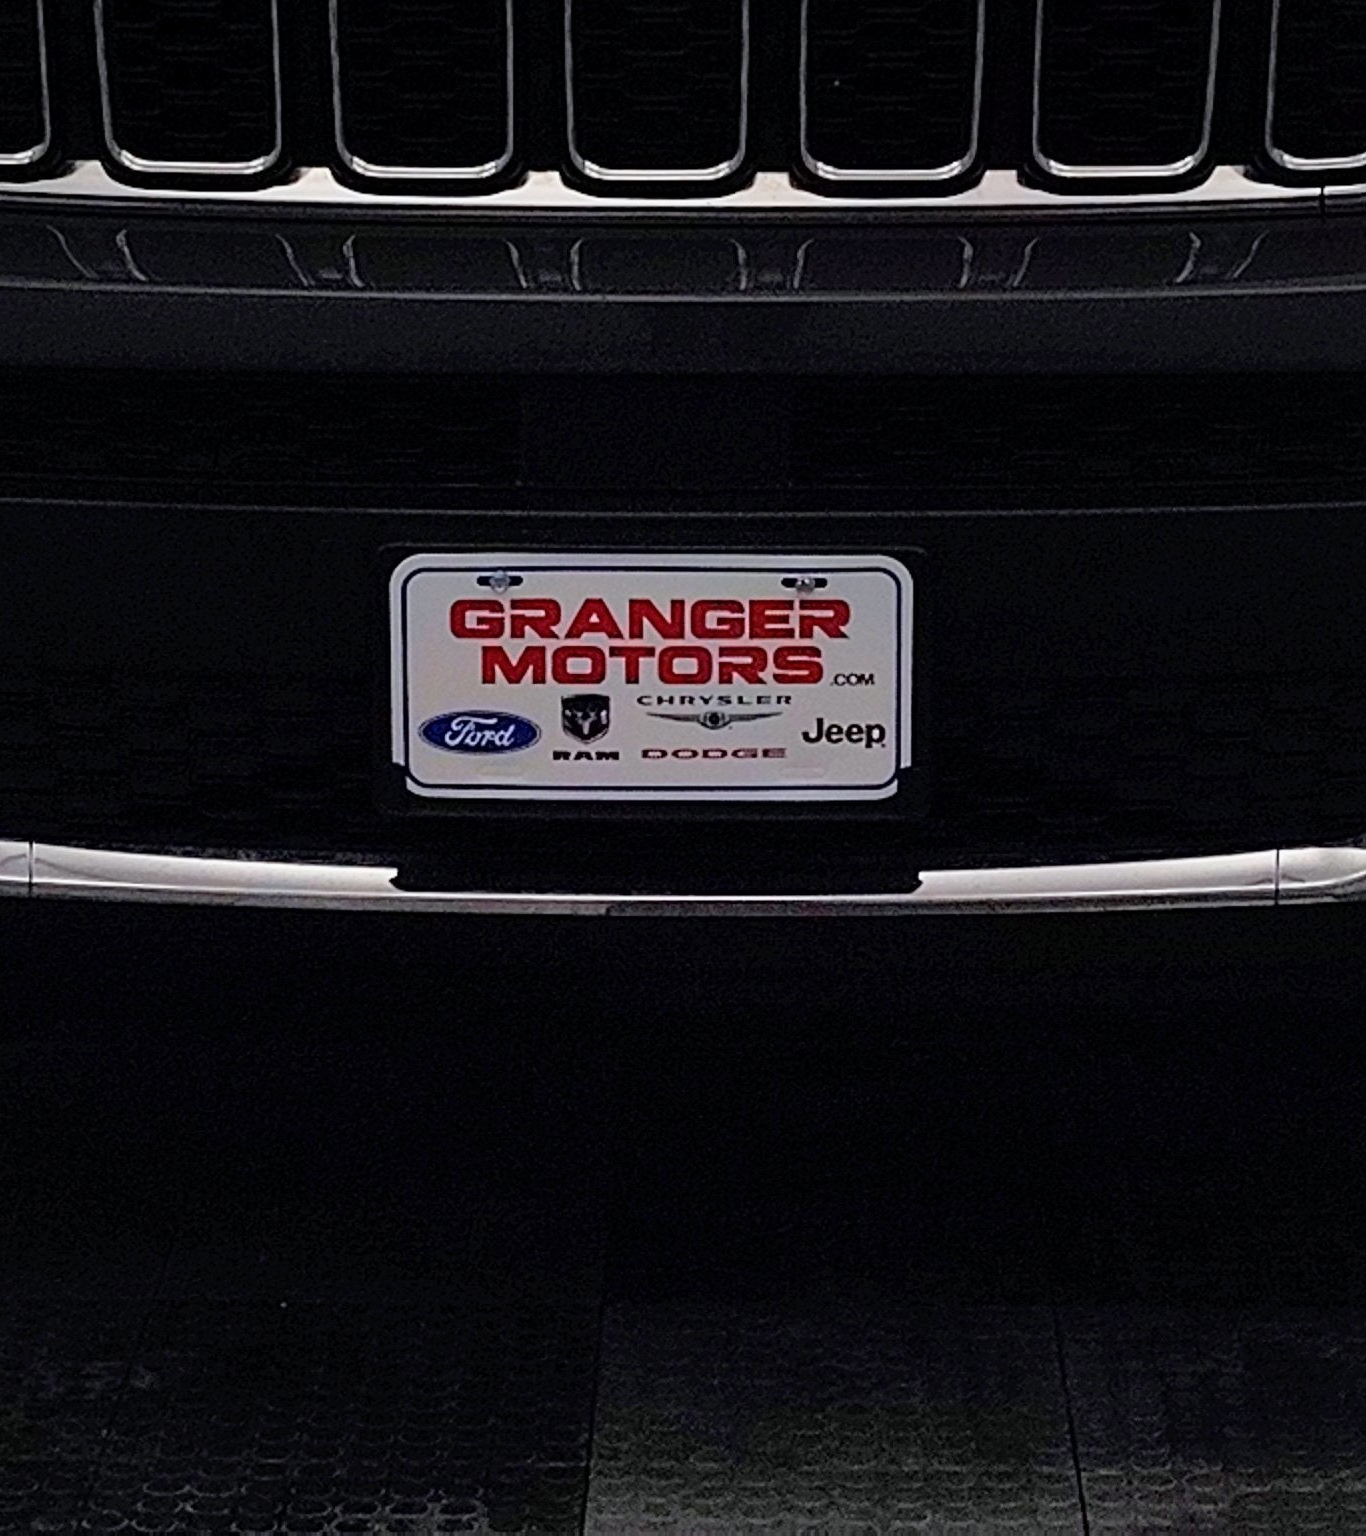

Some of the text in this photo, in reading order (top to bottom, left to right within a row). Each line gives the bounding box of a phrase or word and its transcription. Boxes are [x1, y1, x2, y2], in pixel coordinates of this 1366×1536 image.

[449, 597, 851, 640] GRANGER
[481, 645, 875, 687] MOTORS .COM
[636, 695, 792, 706] CHRYSLER
[443, 715, 516, 747] Ford
[801, 717, 887, 749] Jeep
[552, 750, 620, 761] RAM
[641, 748, 787, 760] DODGE
